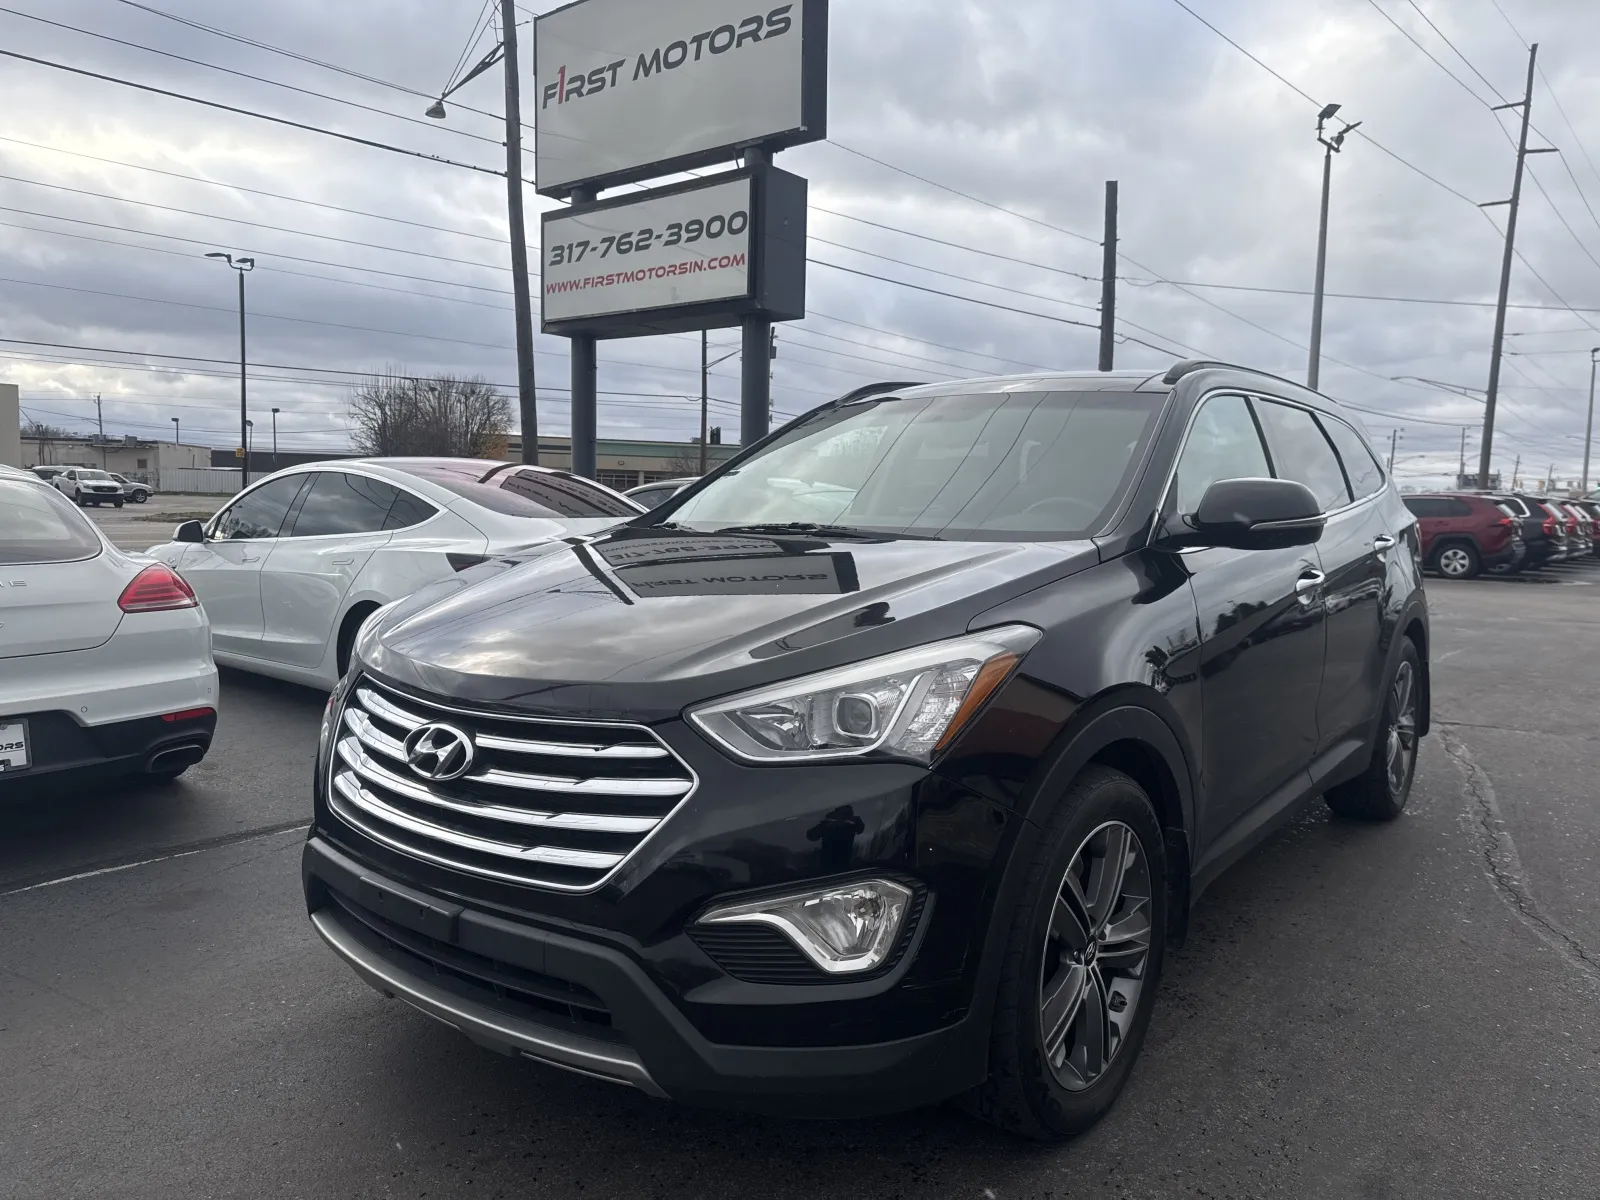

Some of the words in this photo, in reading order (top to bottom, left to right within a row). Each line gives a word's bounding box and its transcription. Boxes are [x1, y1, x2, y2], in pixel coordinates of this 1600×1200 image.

[632, 3, 794, 81] MOTORS
[548, 210, 748, 267] 317-762-3900
[545, 253, 746, 295] WWW.FIRSTMOTORSIN.COM
